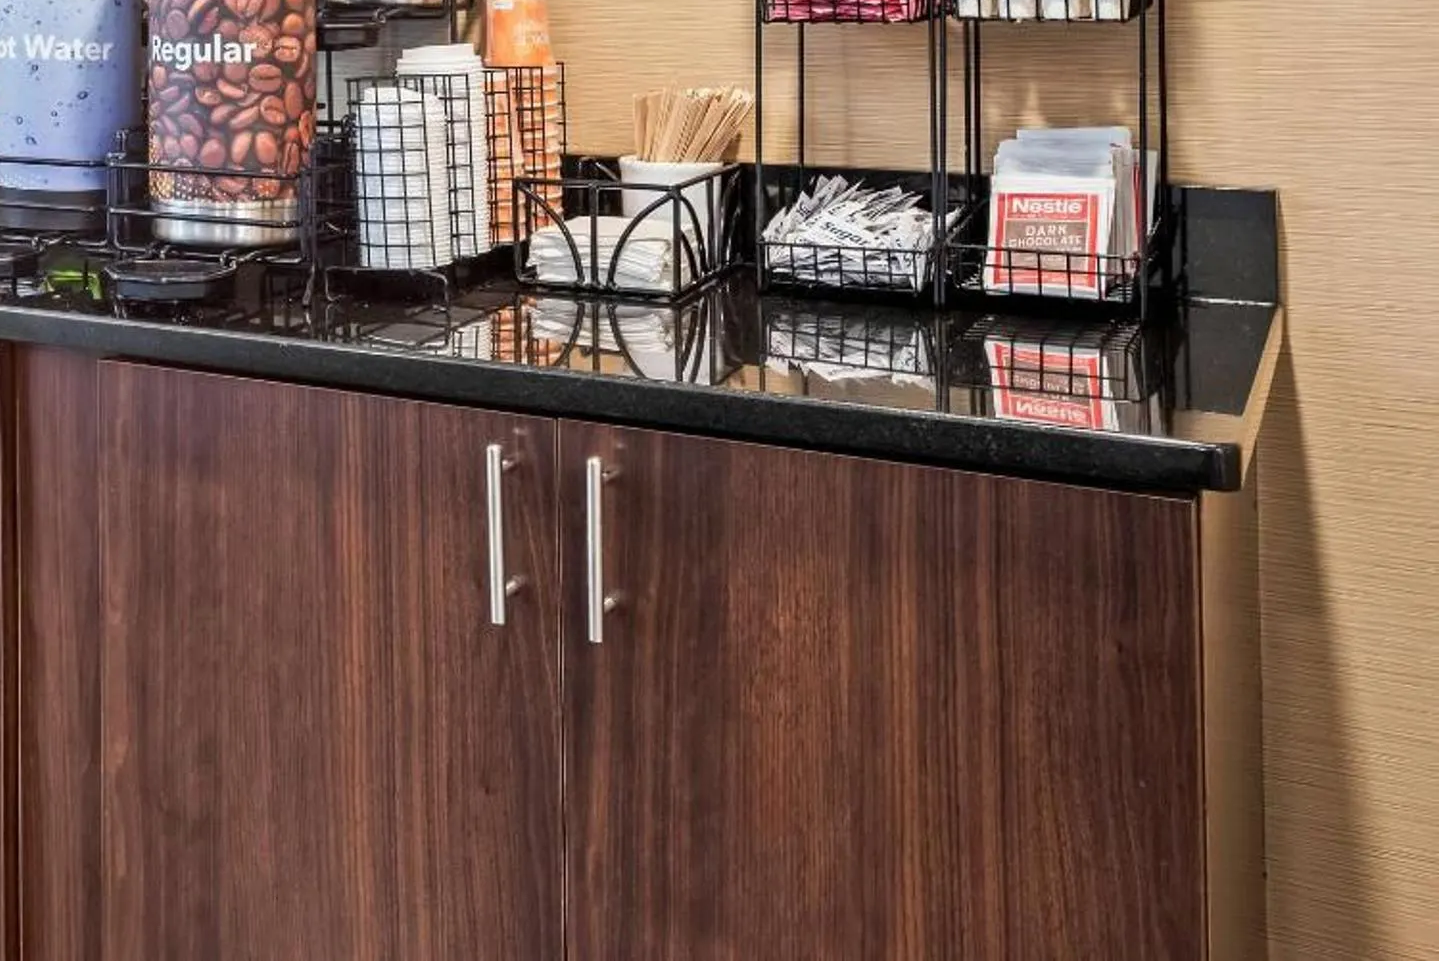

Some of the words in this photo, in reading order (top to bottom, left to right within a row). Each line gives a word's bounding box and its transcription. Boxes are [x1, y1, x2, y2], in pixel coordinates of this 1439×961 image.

[24, 34, 114, 61] Water
[152, 34, 257, 71] Regular
[1024, 224, 1068, 237] DARK
[1008, 234, 1083, 248] CHOCOLATE
